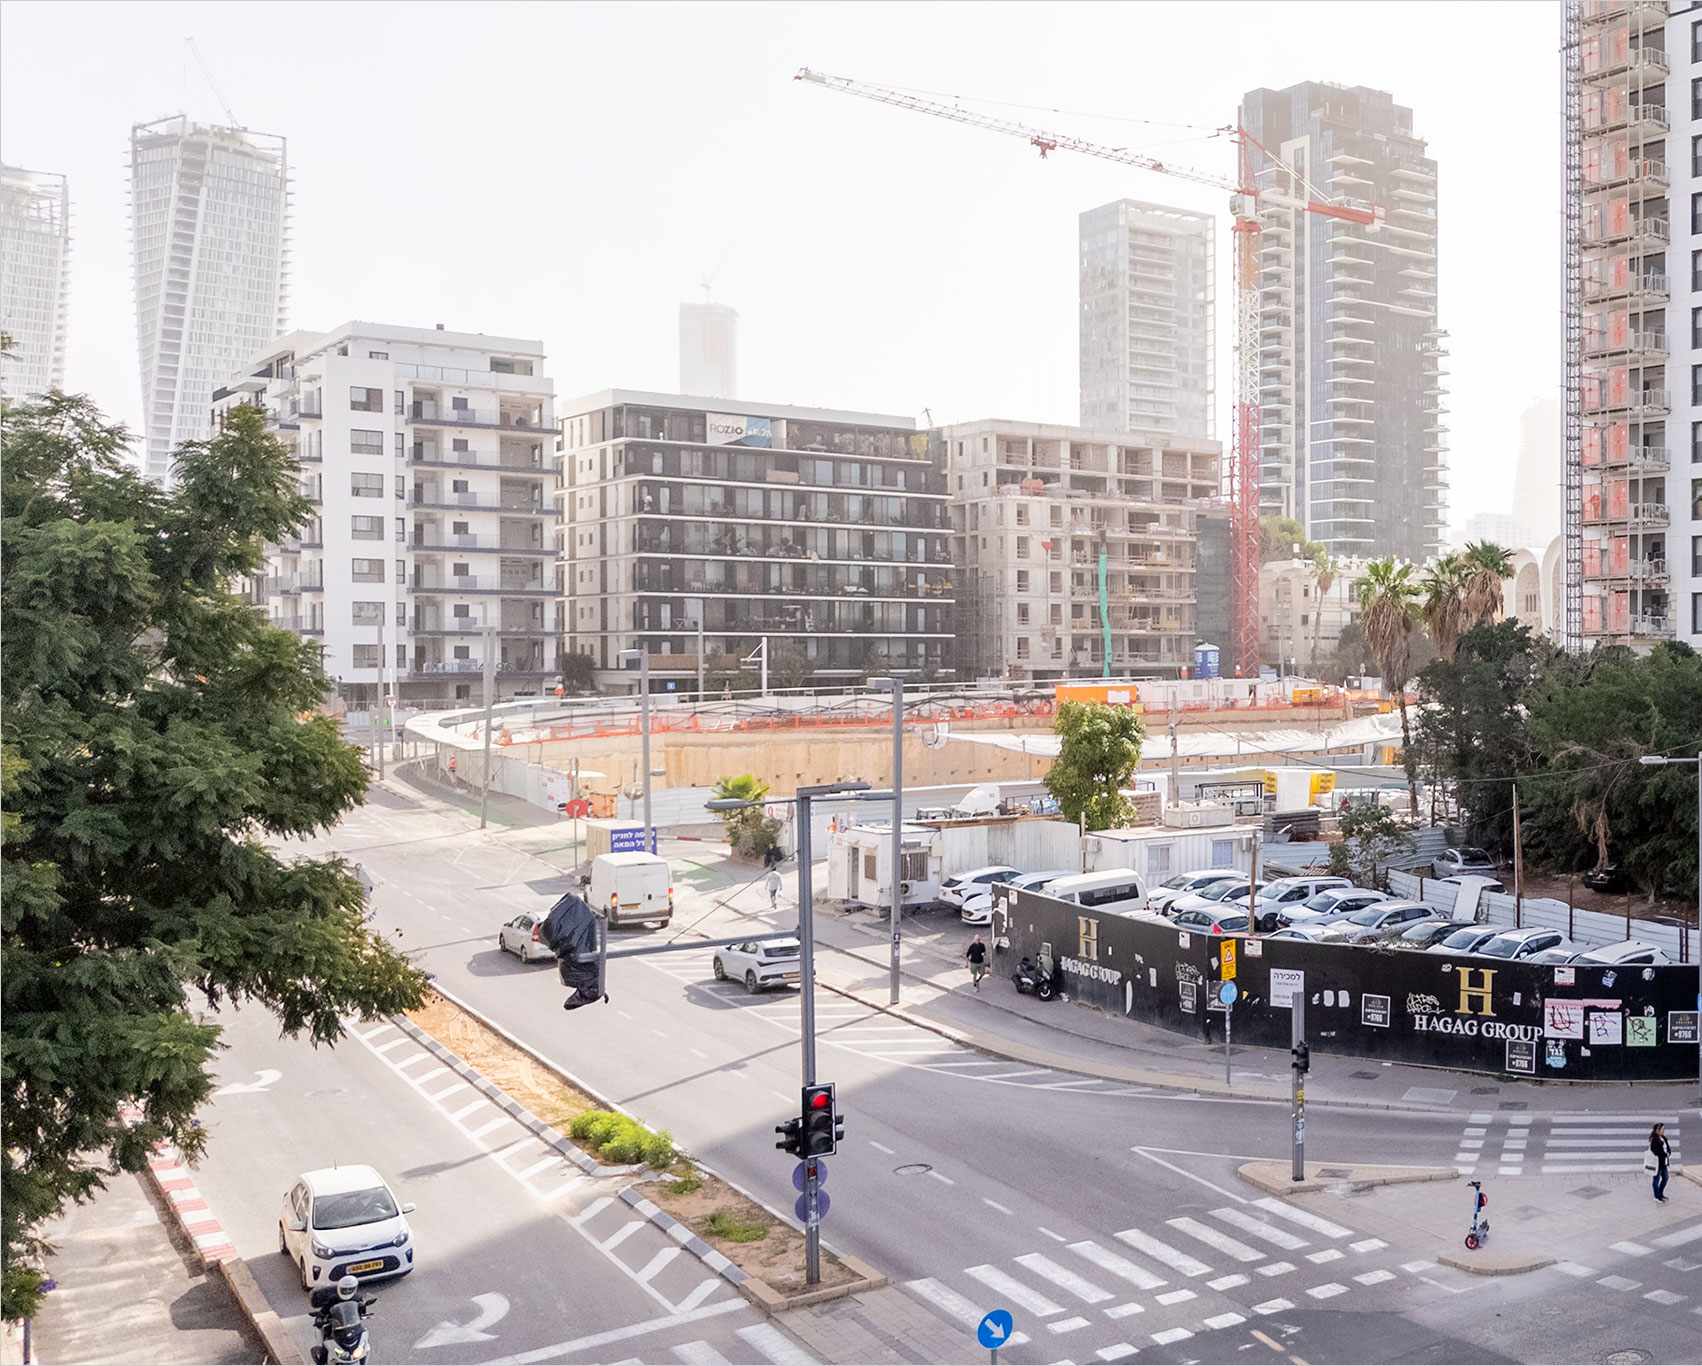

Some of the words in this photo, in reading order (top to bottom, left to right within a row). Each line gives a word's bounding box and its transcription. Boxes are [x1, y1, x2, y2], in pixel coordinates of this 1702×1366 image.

[709, 423, 744, 435] ROZIO
[1273, 972, 1301, 981] למכירה
[1413, 1014, 1479, 1036] HAGAG
[1481, 1021, 1543, 1042] GROUP
